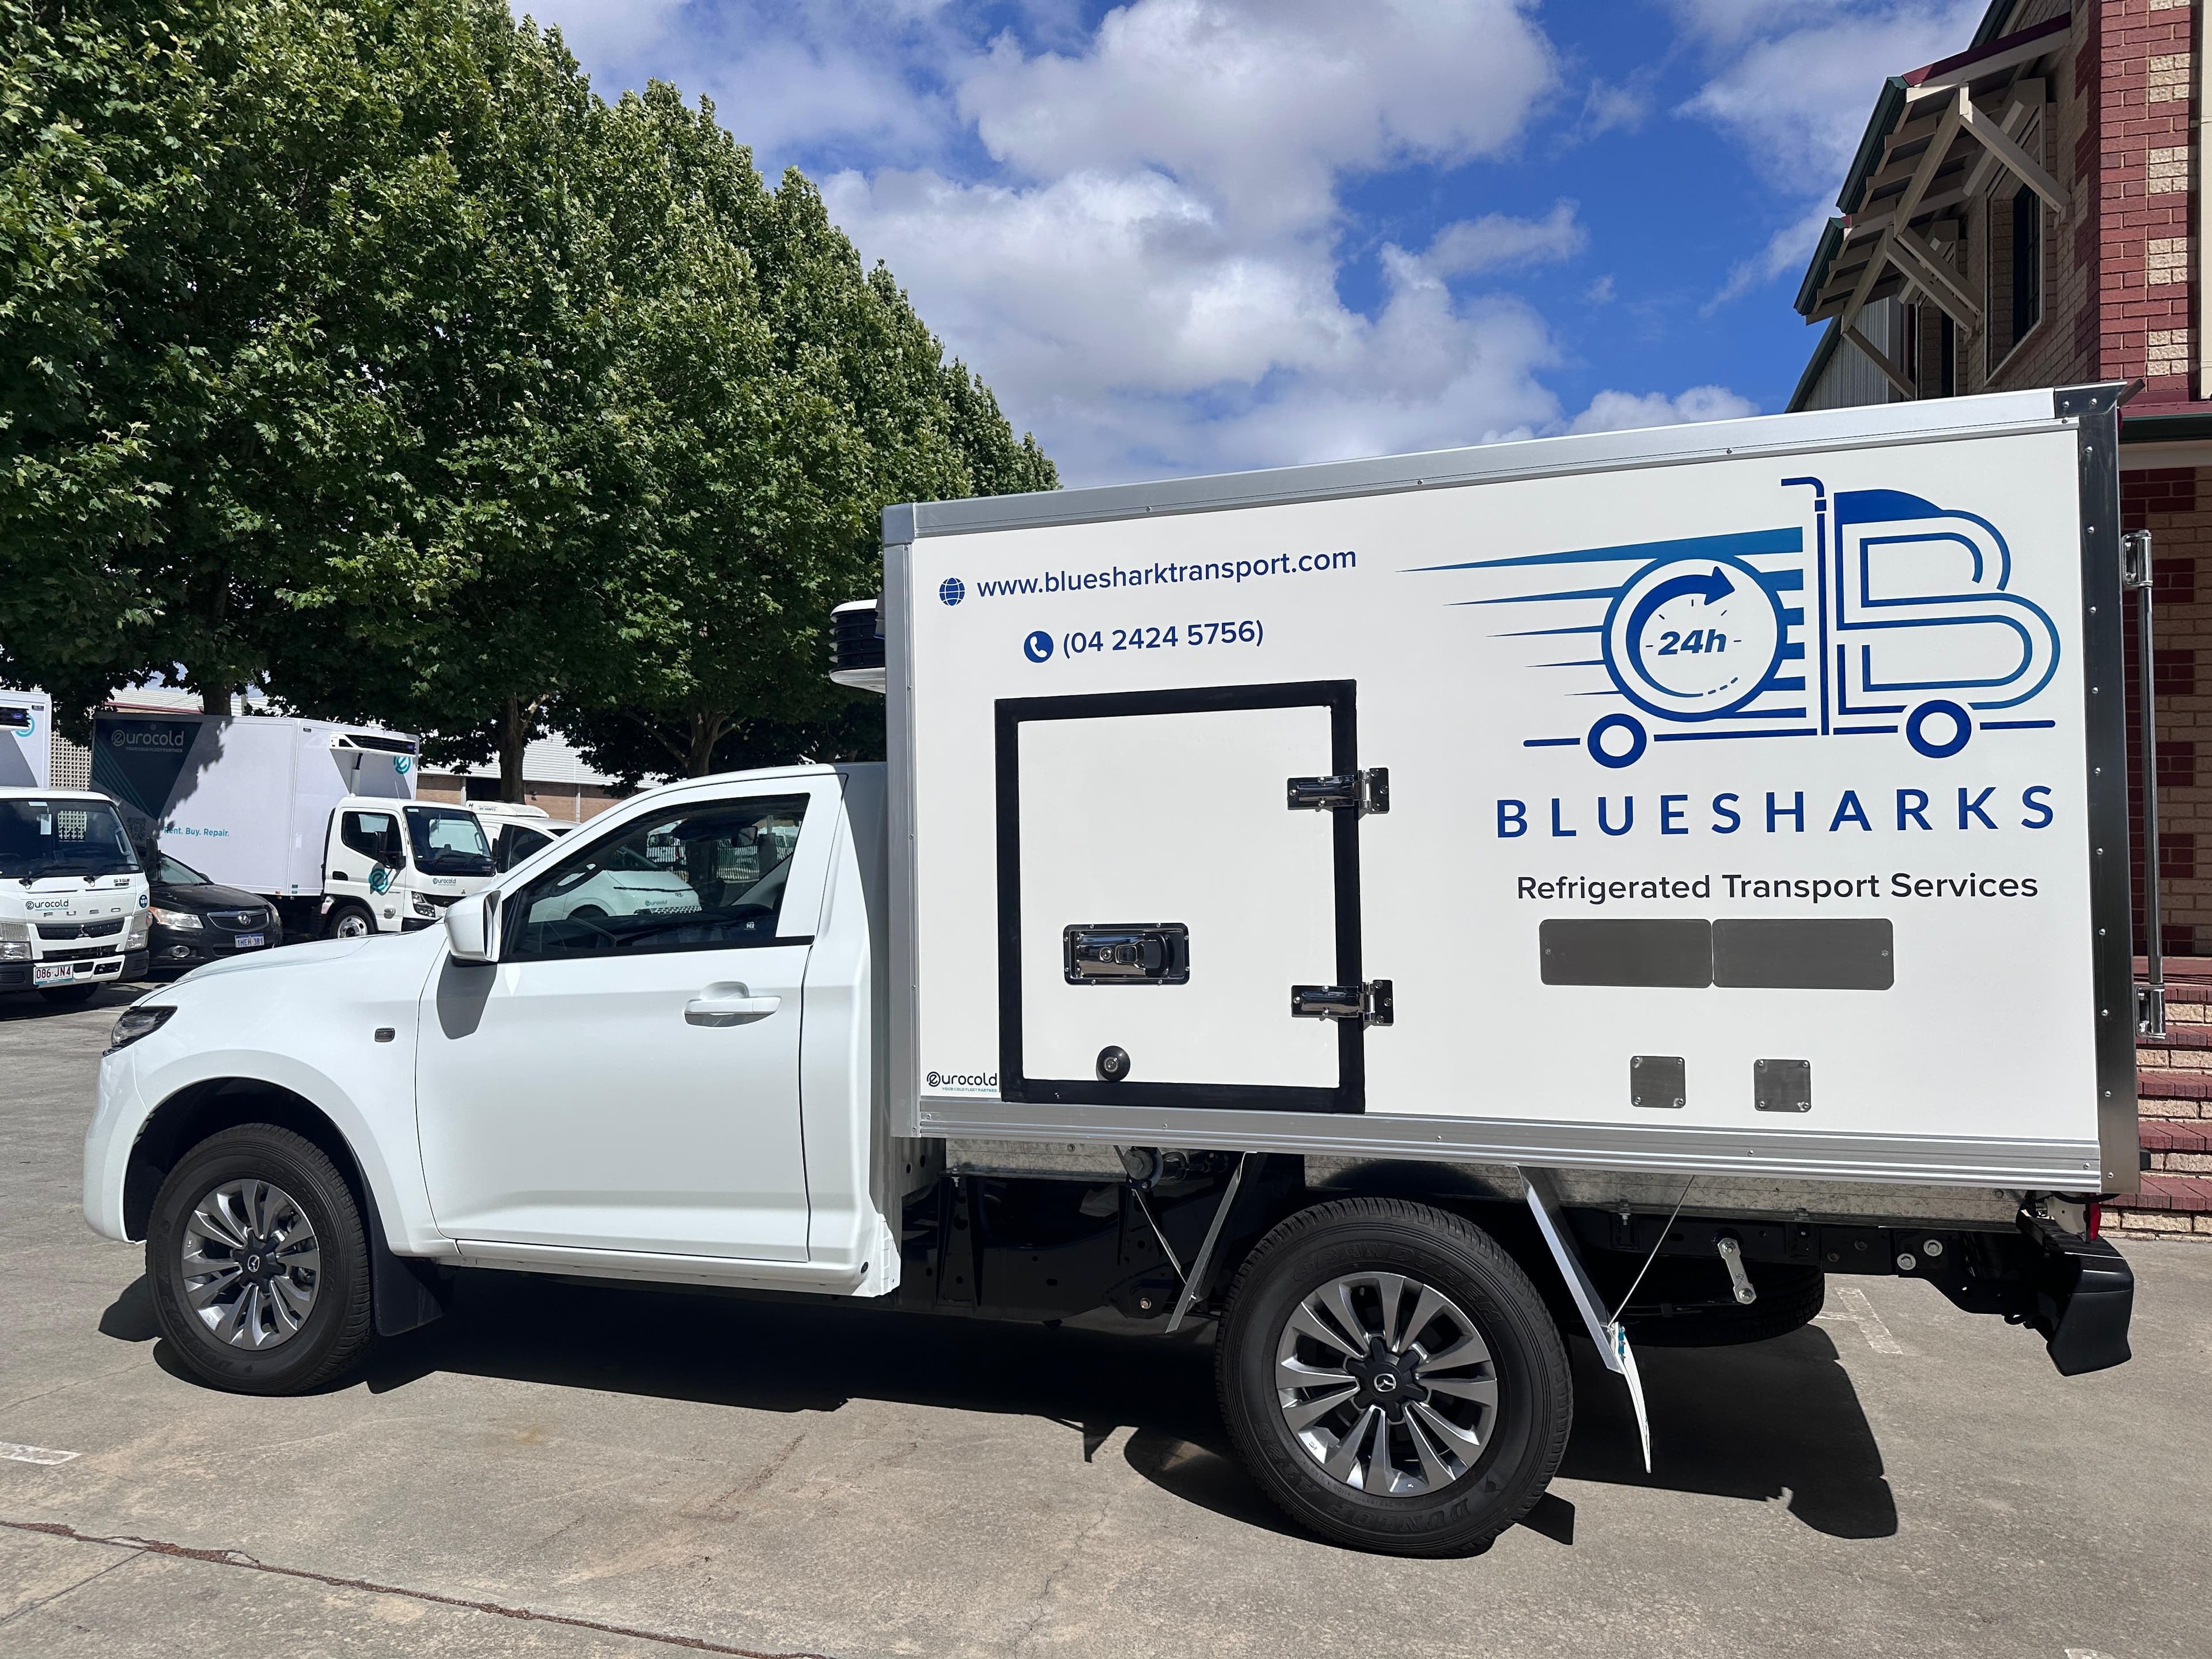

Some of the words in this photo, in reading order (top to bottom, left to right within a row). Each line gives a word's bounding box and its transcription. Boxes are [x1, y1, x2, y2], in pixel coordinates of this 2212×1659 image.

[976, 551, 1356, 597] www.bluesharktransport.com
[1063, 631, 1104, 660] (04
[1112, 626, 1179, 651] 2424
[1188, 619, 1264, 647] 5756)
[1657, 628, 1727, 656] 24h
[111, 730, 184, 747] eurocold
[1497, 785, 2054, 838] BLUESHARKS
[185, 828, 202, 836] Buy.
[203, 829, 230, 837] Repair.
[1518, 874, 1710, 905] Refrigerated
[1721, 874, 1880, 904] Transport
[1891, 872, 2038, 897] Services
[25, 899, 69, 910] eurocold
[36, 968, 51, 979] 086
[54, 966, 71, 977] JN4
[926, 1071, 998, 1088] eurocold
